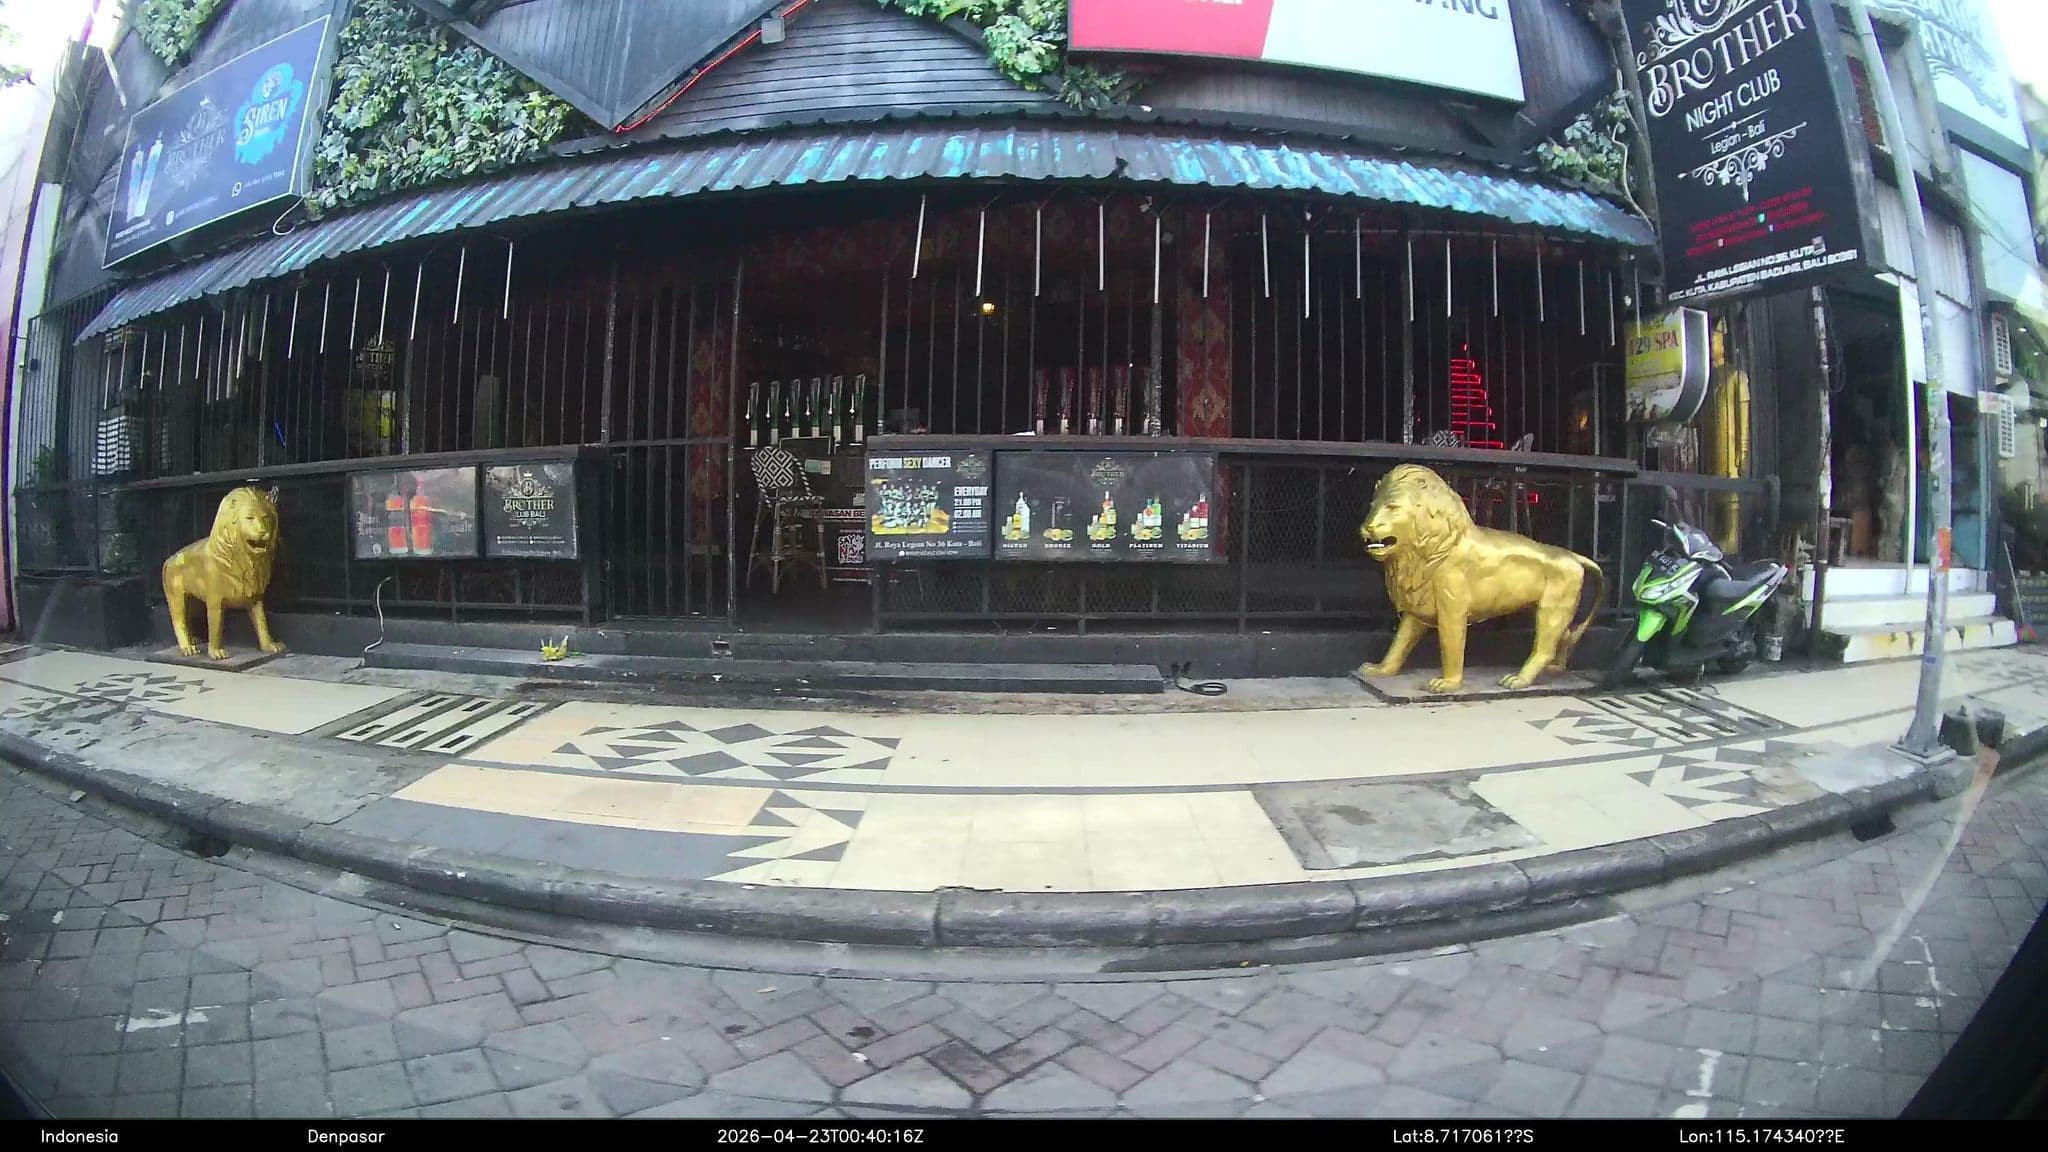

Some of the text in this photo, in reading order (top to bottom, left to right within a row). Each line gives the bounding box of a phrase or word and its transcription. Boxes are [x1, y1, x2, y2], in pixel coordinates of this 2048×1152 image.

[1647, 0, 1807, 117] BROTHER
[1685, 68, 1782, 132] NIGHT CLUB
[236, 97, 288, 145] SIREN
[1711, 132, 1742, 154] Legian
[1748, 119, 1767, 138] Bali
[1708, 272, 1759, 291] KABUPATEN
[1803, 255, 1827, 271] BALI
[1655, 328, 1679, 350] SPA
[903, 457, 922, 469] SEXY
[922, 456, 952, 468] DANCER
[503, 499, 554, 512] BROTHER
[953, 486, 988, 496] EVERYDAY
